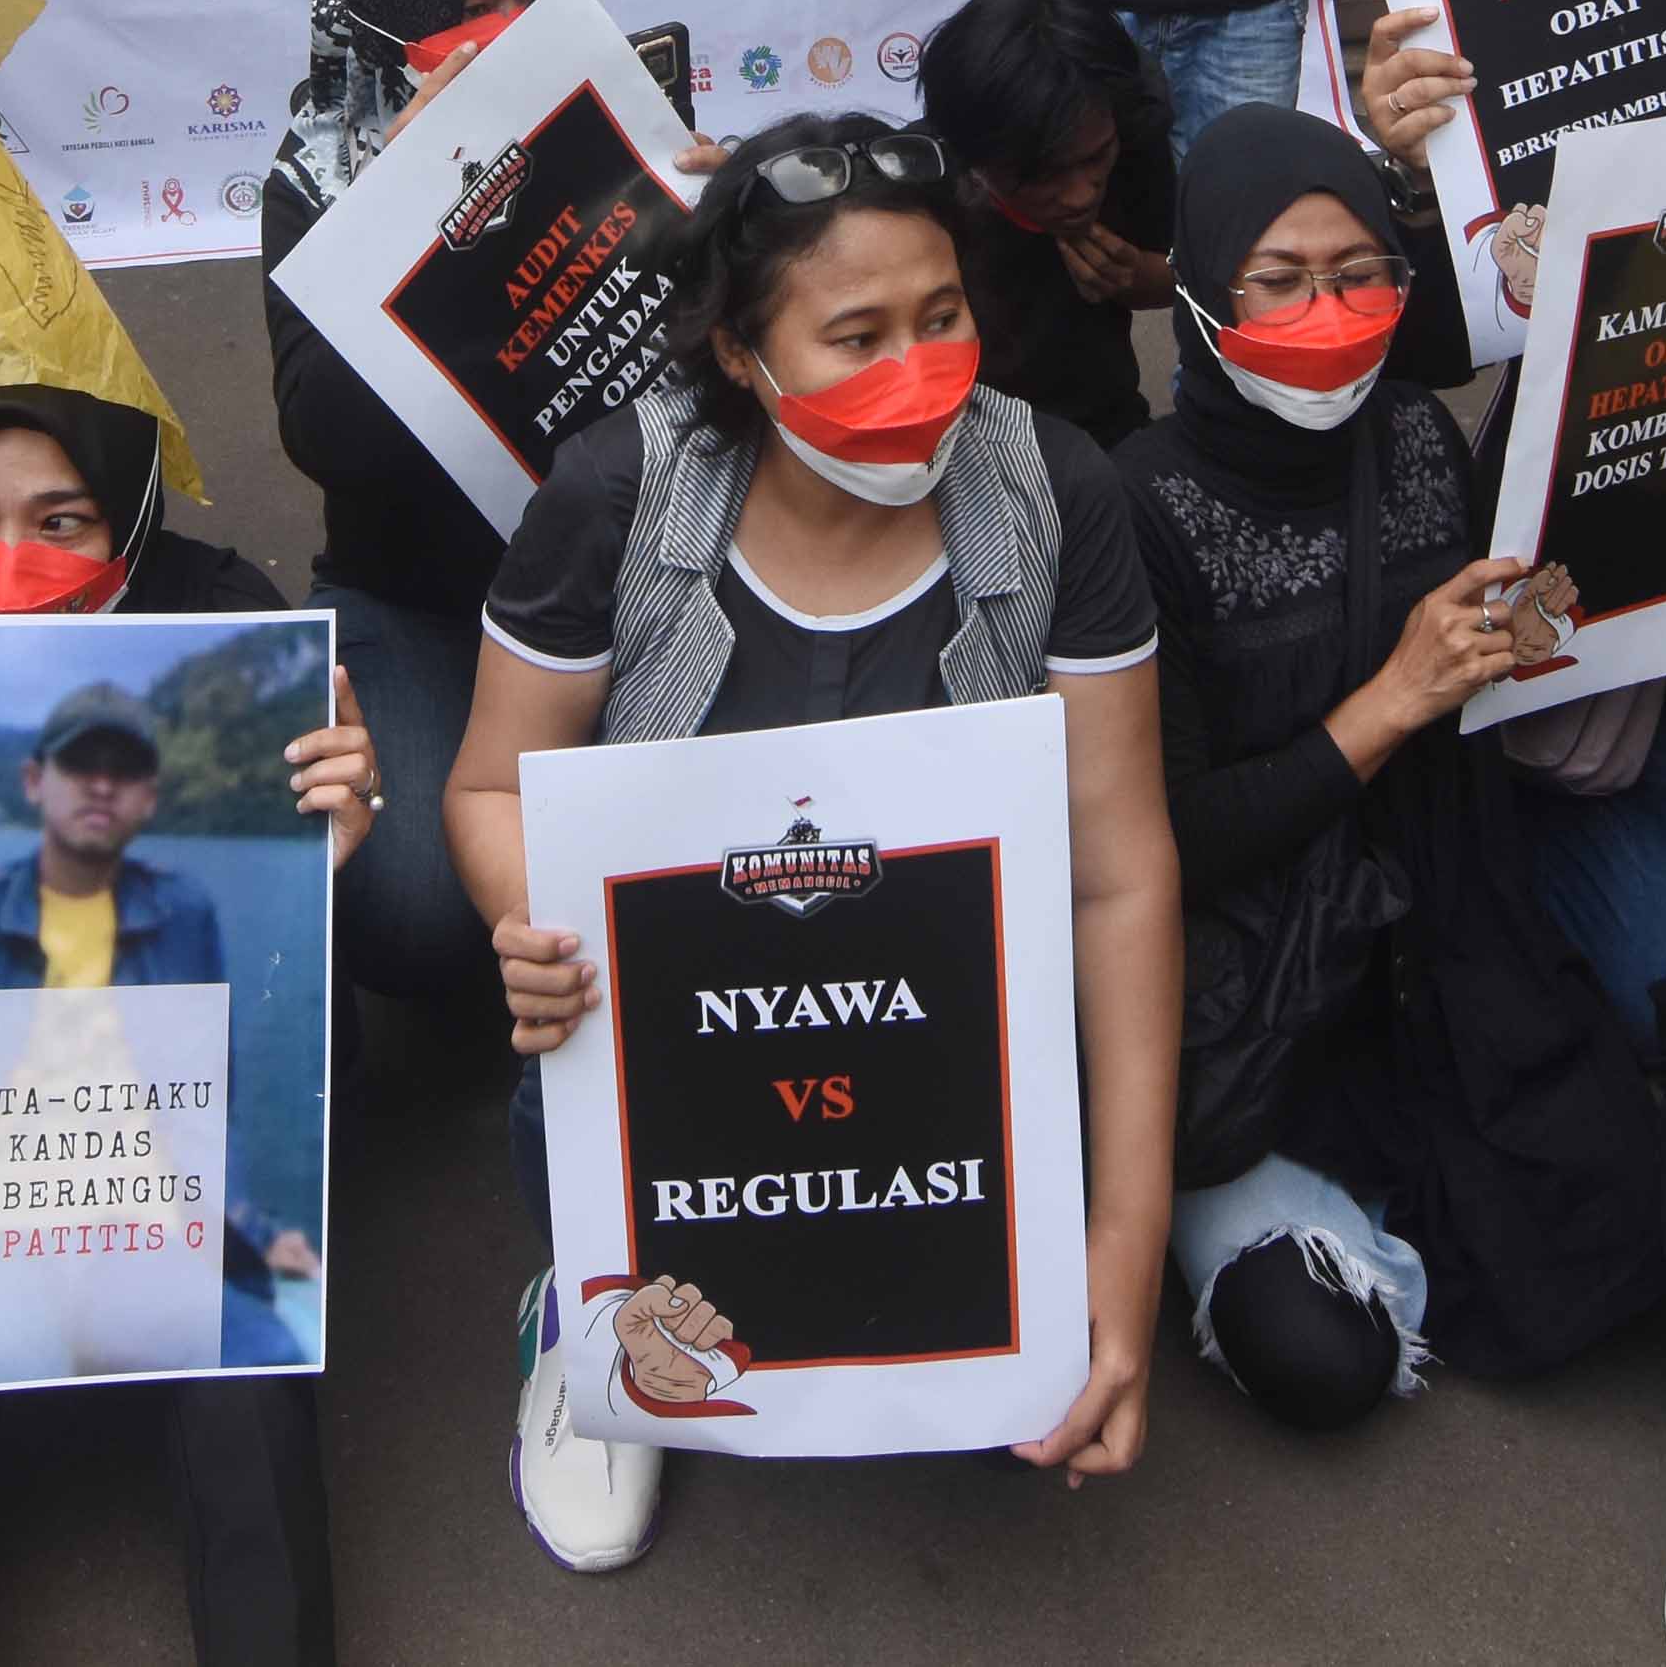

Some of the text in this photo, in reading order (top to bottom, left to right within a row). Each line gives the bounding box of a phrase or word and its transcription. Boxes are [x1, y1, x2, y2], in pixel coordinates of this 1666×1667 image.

[188, 121, 266, 135] KARISMA
[446, 148, 526, 242] KOMUNITAS
[495, 201, 637, 374] KEMENKES
[505, 205, 584, 310] AUDIT
[545, 256, 641, 367] UNTUK
[534, 273, 675, 436] PENGADAA
[602, 322, 670, 407] OBAT
[1571, 451, 1653, 497] DOSIS
[733, 848, 871, 883] KOMUNITAS
[695, 977, 927, 1034] NYAWA
[772, 1075, 855, 1122] VS
[10, 1131, 152, 1162] KANDAS
[653, 1159, 985, 1222] REGULASI
[187, 1221, 204, 1249] C
